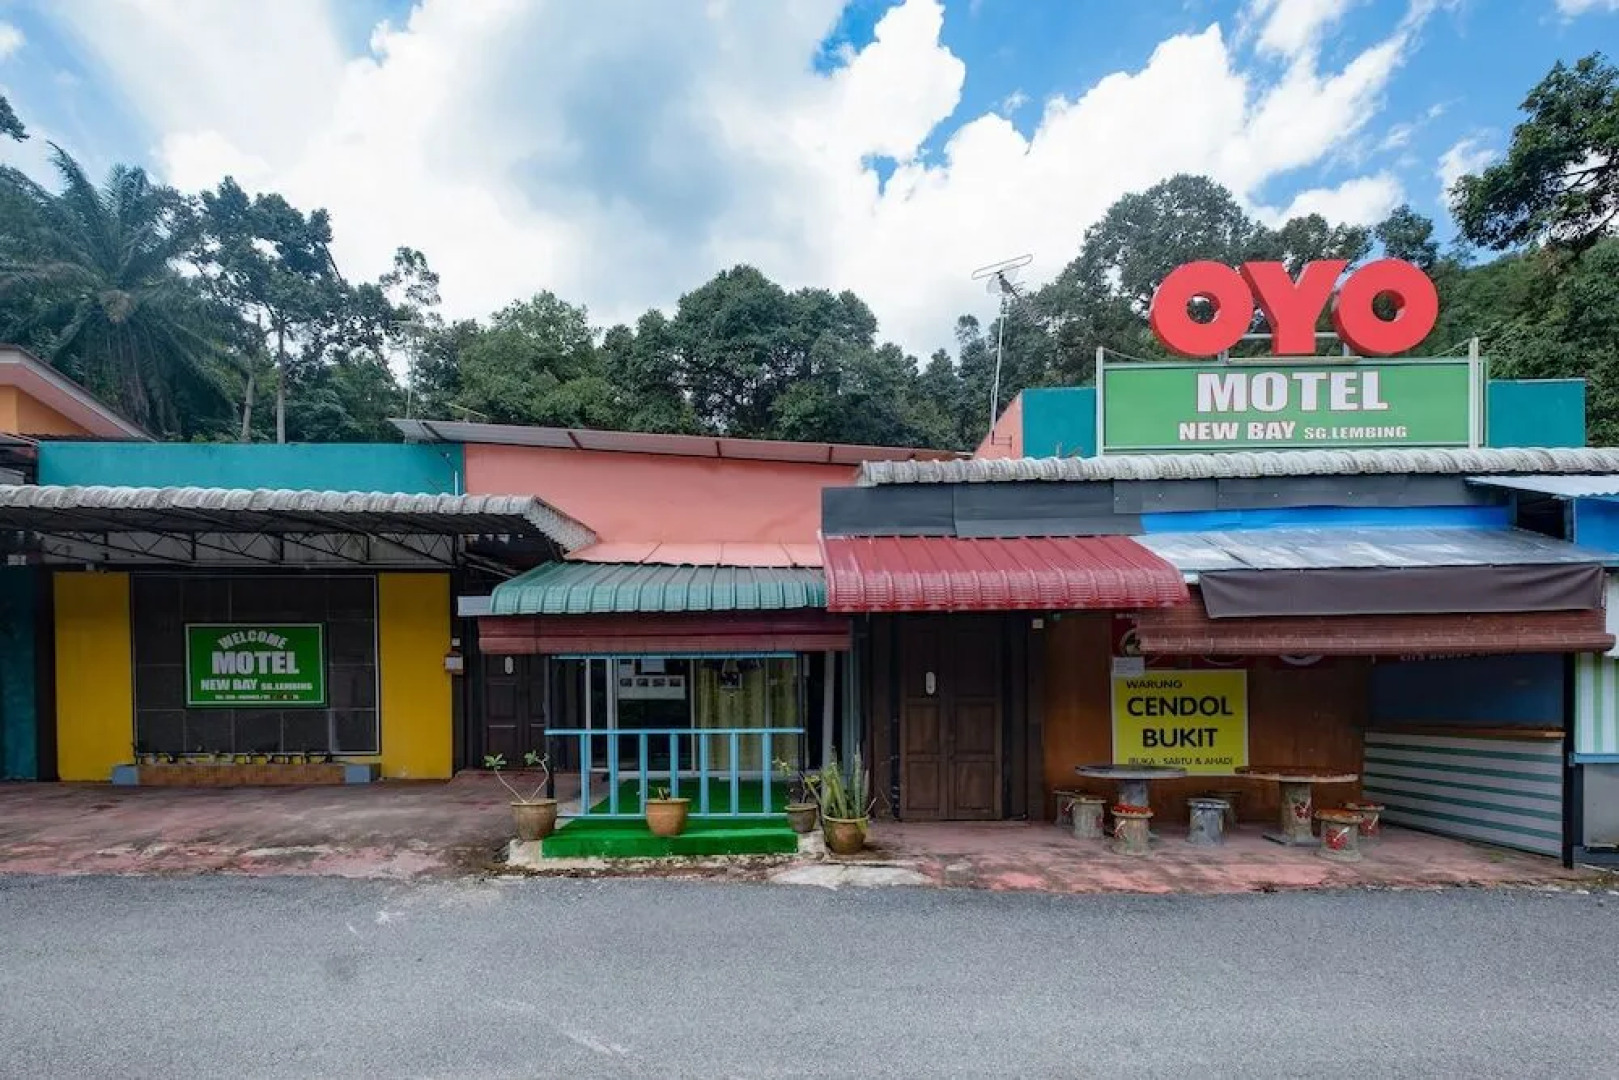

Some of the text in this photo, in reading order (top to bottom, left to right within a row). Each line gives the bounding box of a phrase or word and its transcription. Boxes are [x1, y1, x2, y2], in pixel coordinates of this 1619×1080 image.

[1151, 258, 1439, 356] OYO
[1196, 371, 1389, 413] MOTEL
[1179, 422, 1239, 440] NEW
[1247, 421, 1296, 439] BAY
[218, 630, 288, 649] WELCOME
[212, 651, 300, 674] MOTEL
[201, 679, 230, 690] NEW
[233, 678, 258, 690] BAY
[1126, 680, 1182, 688] WARUNG
[1127, 696, 1234, 716] CENDOL
[1143, 728, 1218, 747] BUKIT
